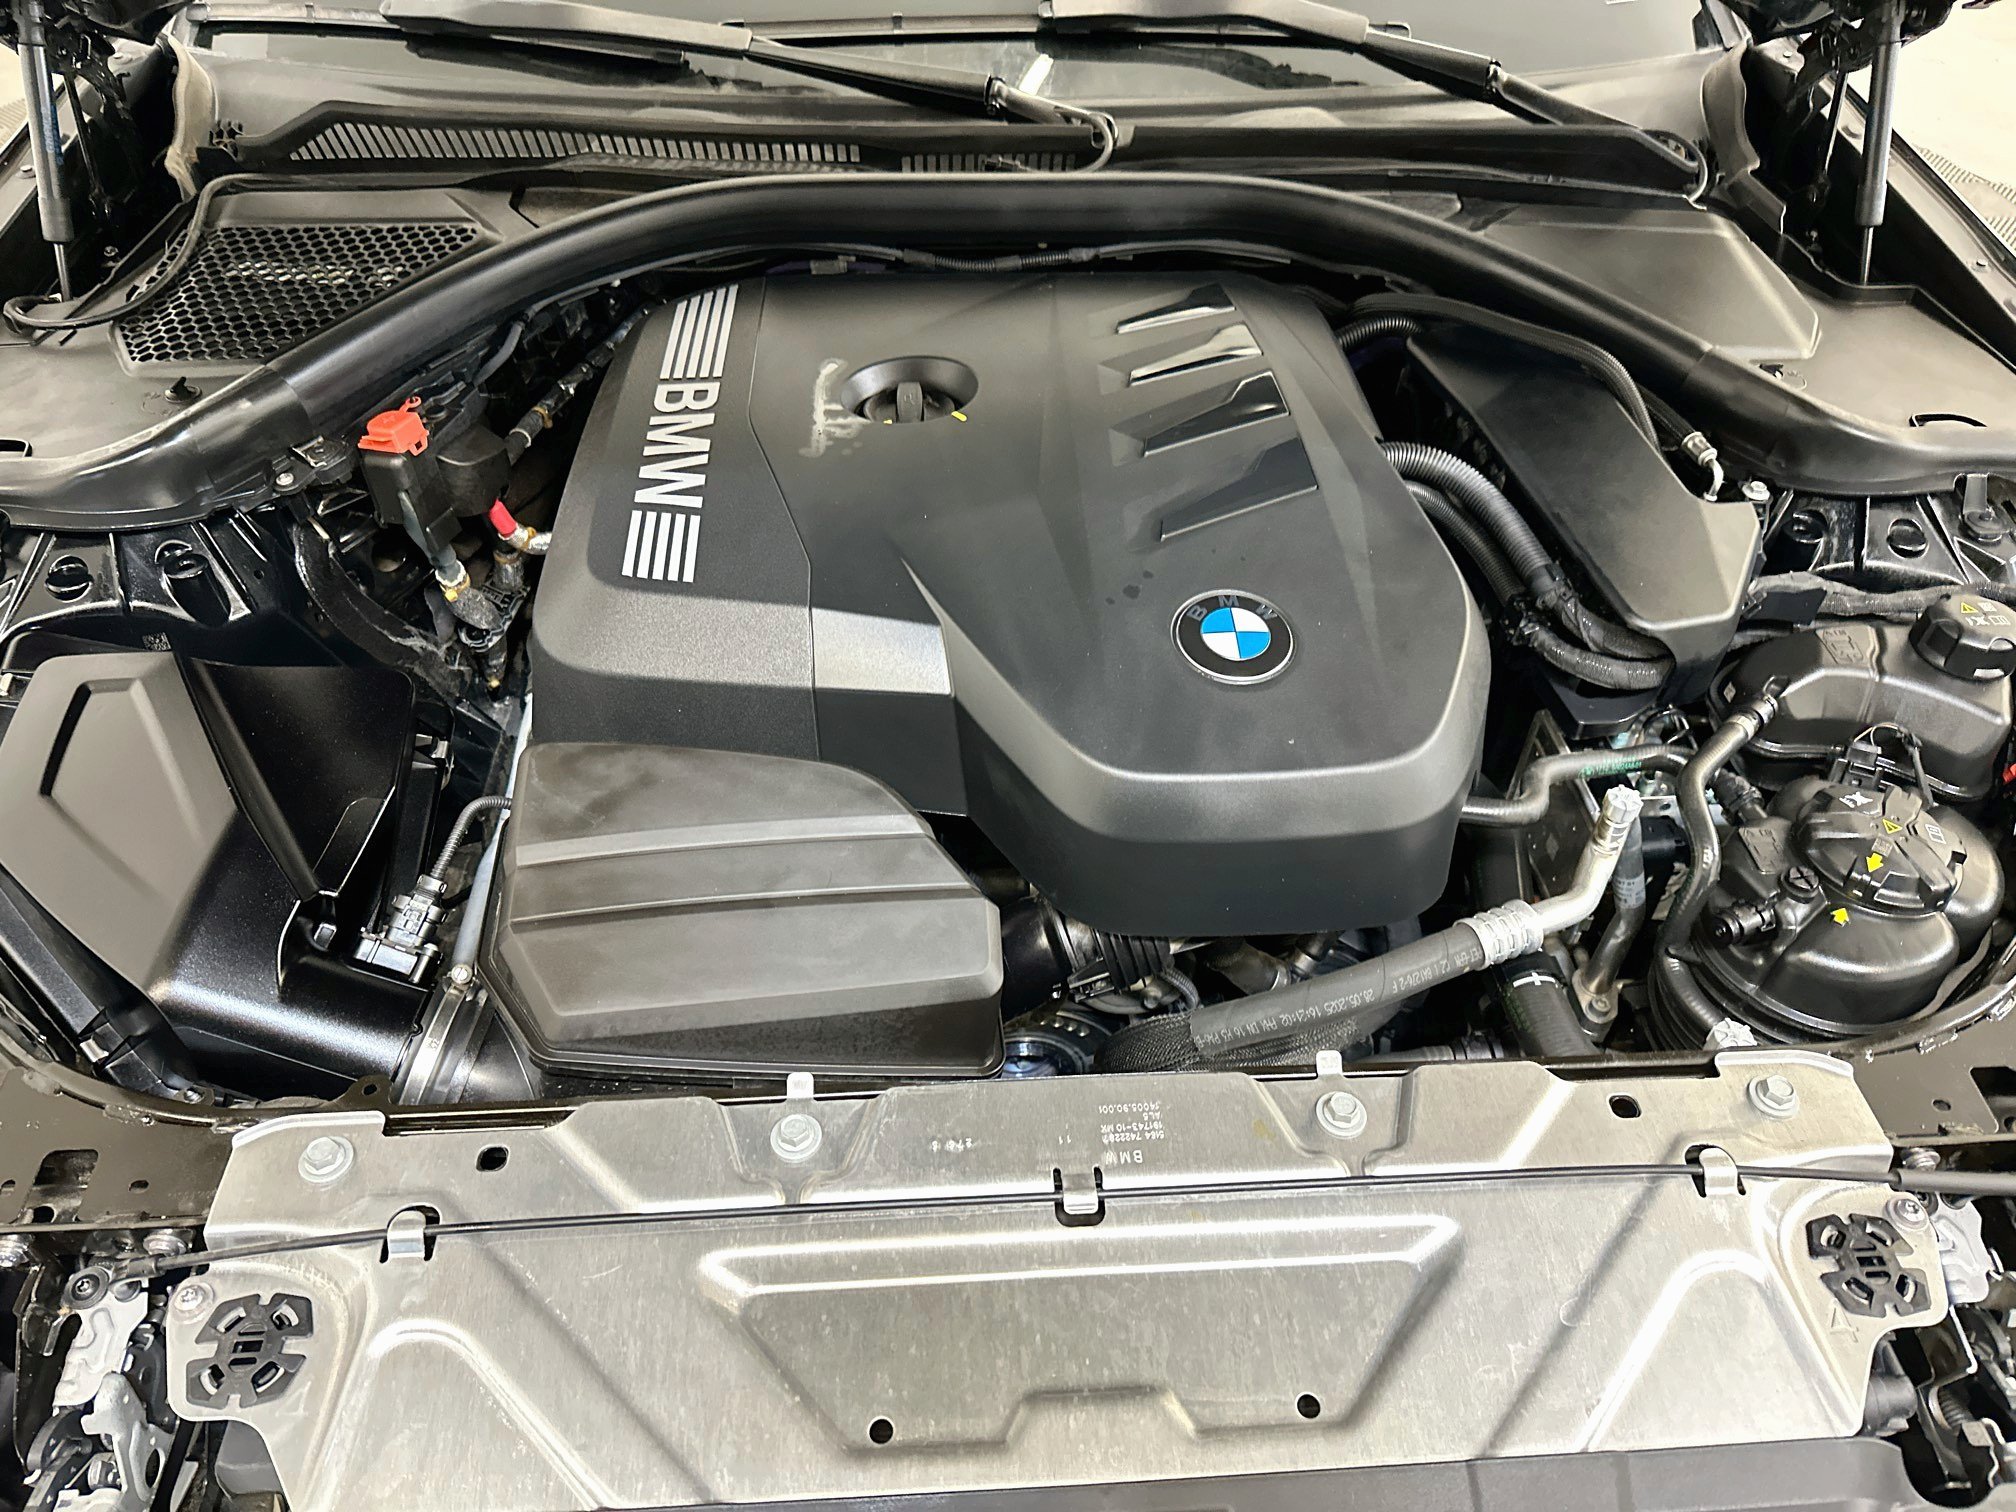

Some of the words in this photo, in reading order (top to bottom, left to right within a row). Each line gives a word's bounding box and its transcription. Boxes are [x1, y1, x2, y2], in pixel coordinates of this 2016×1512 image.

[634, 381, 720, 509] BMW
[1186, 595, 1278, 622] BMW
[1279, 1005, 1321, 1026] 16:21:02
